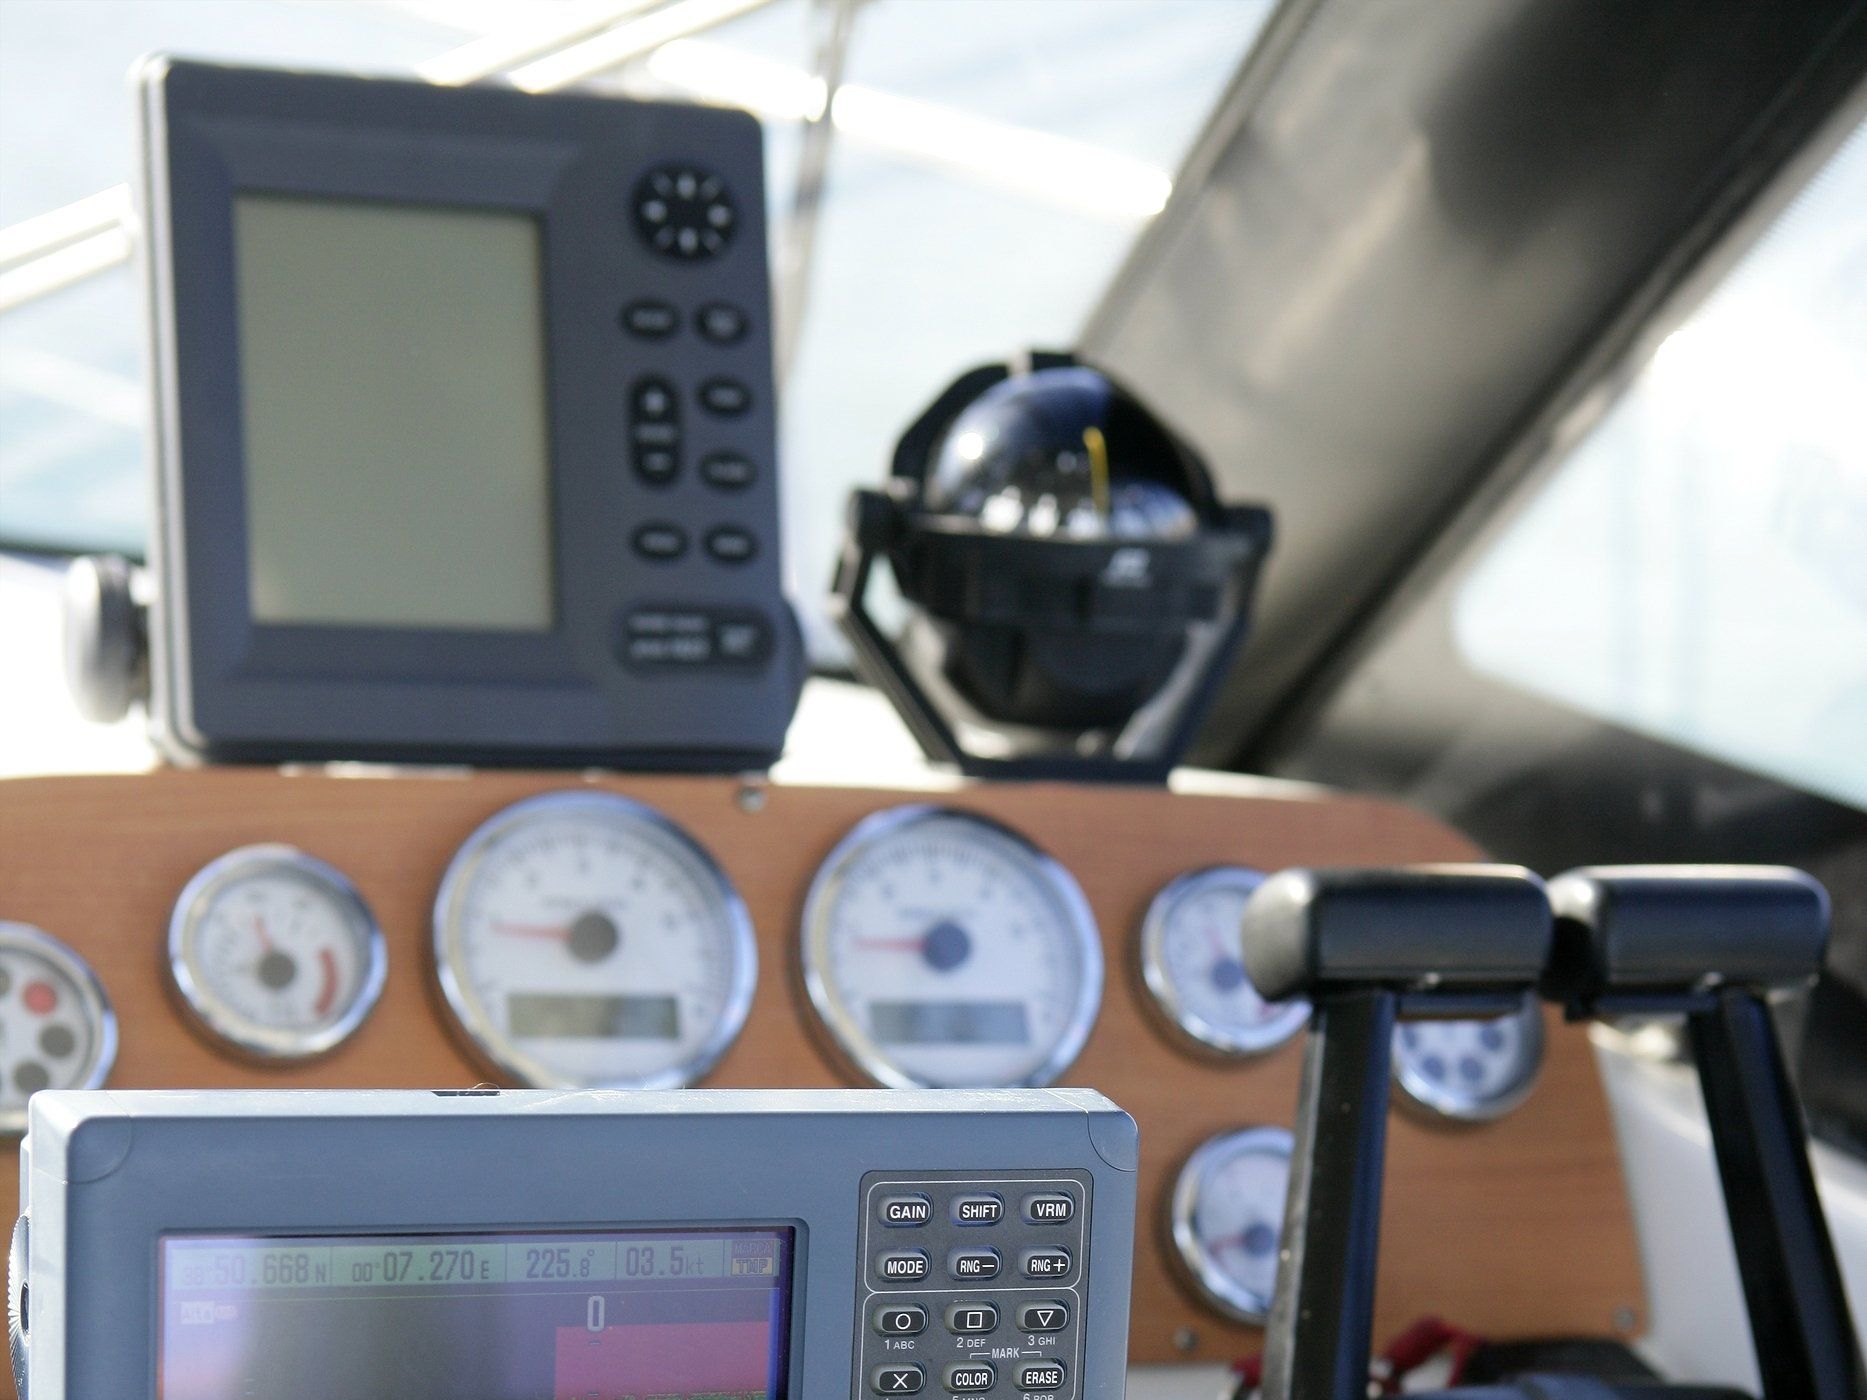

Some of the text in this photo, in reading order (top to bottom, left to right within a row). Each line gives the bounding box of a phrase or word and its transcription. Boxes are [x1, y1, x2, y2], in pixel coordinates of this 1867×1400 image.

[889, 1204, 926, 1219] GAIN
[962, 1204, 997, 1219] SHIFT
[1036, 1203, 1067, 1218] VRM
[887, 1260, 924, 1274] MODE
[586, 1295, 605, 1333] 0
[884, 1339, 915, 1350] 1 ABC
[956, 1337, 986, 1348] 2 DEF
[1027, 1335, 1056, 1346] 3 GHI
[991, 1348, 1020, 1359] MARK
[955, 1372, 988, 1386] COLOR
[1025, 1370, 1058, 1384] ERASE
